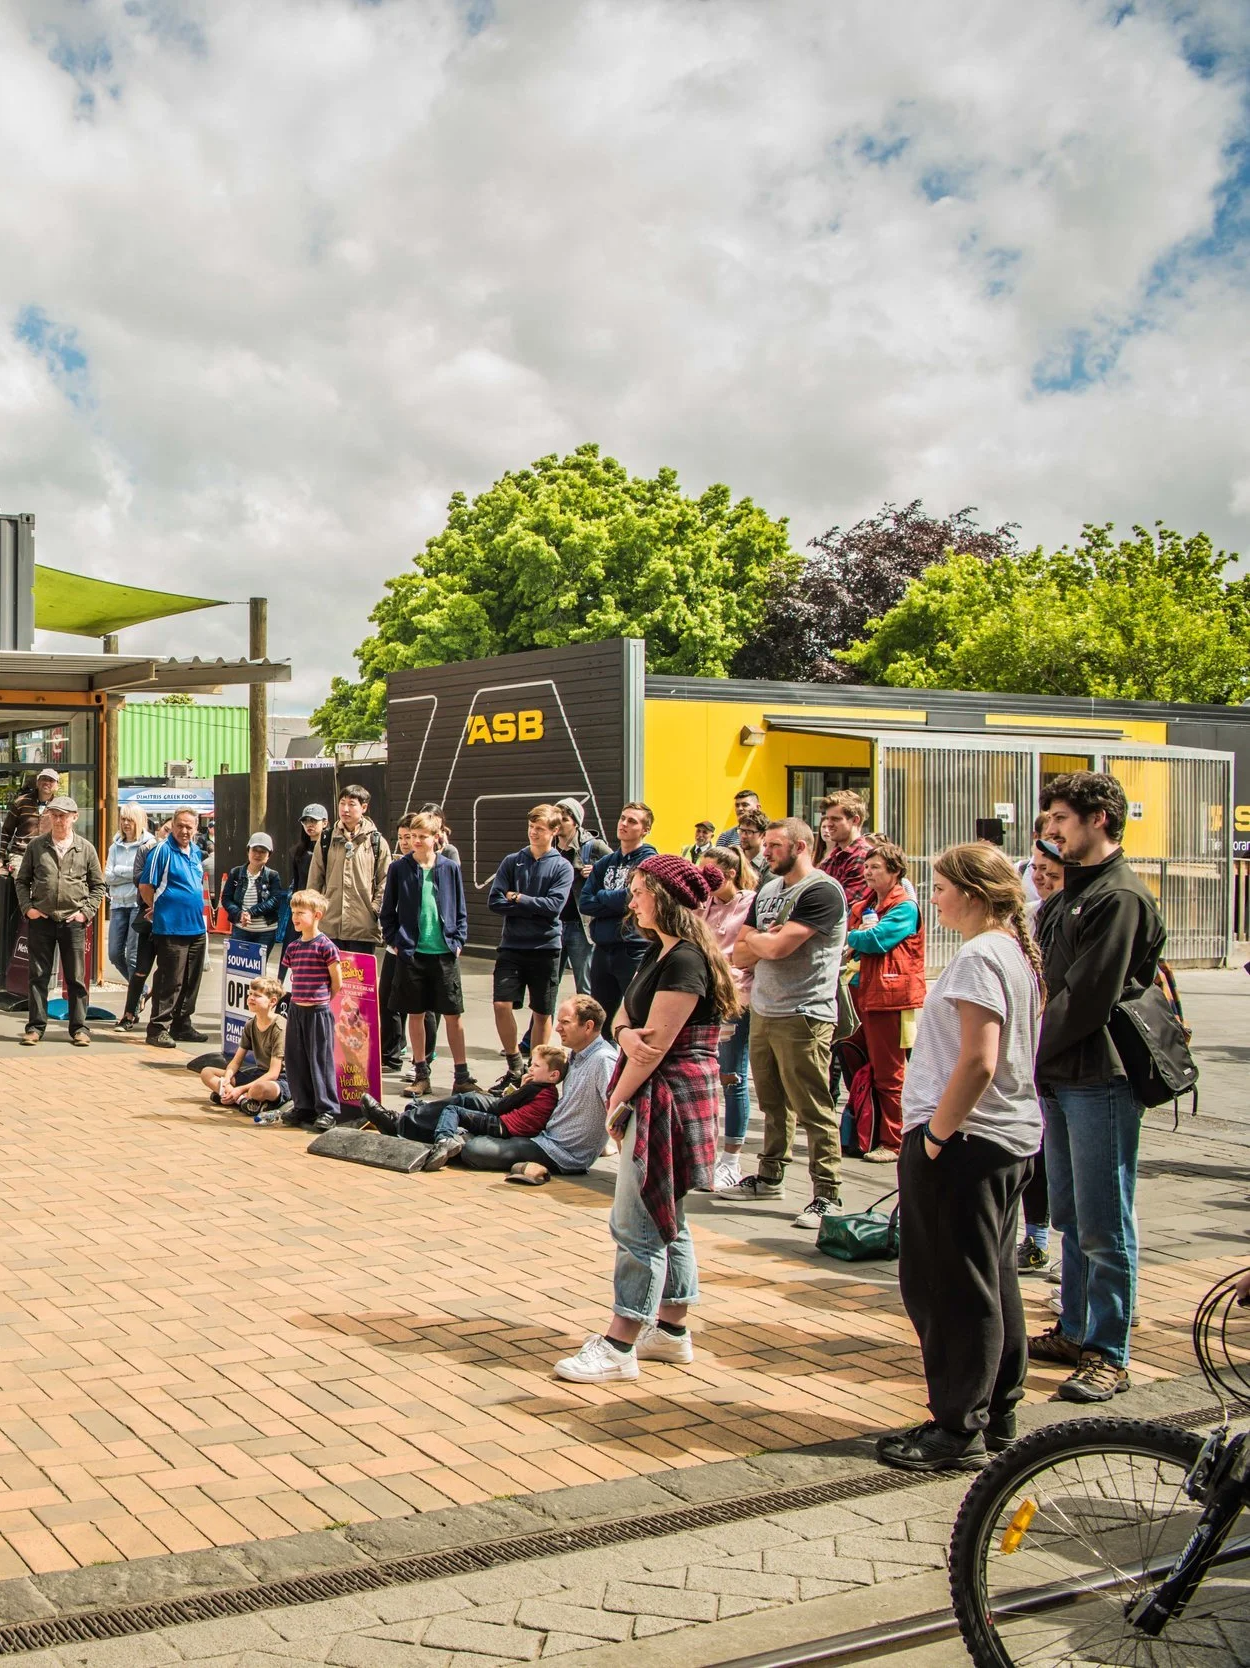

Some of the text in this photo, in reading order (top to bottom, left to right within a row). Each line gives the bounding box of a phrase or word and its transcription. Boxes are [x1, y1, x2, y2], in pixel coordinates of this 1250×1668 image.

[467, 709, 544, 745] ASB
[227, 954, 261, 971] SOUVLAKI
[227, 980, 250, 1011] OPE
[341, 1088, 363, 1101] Choic
